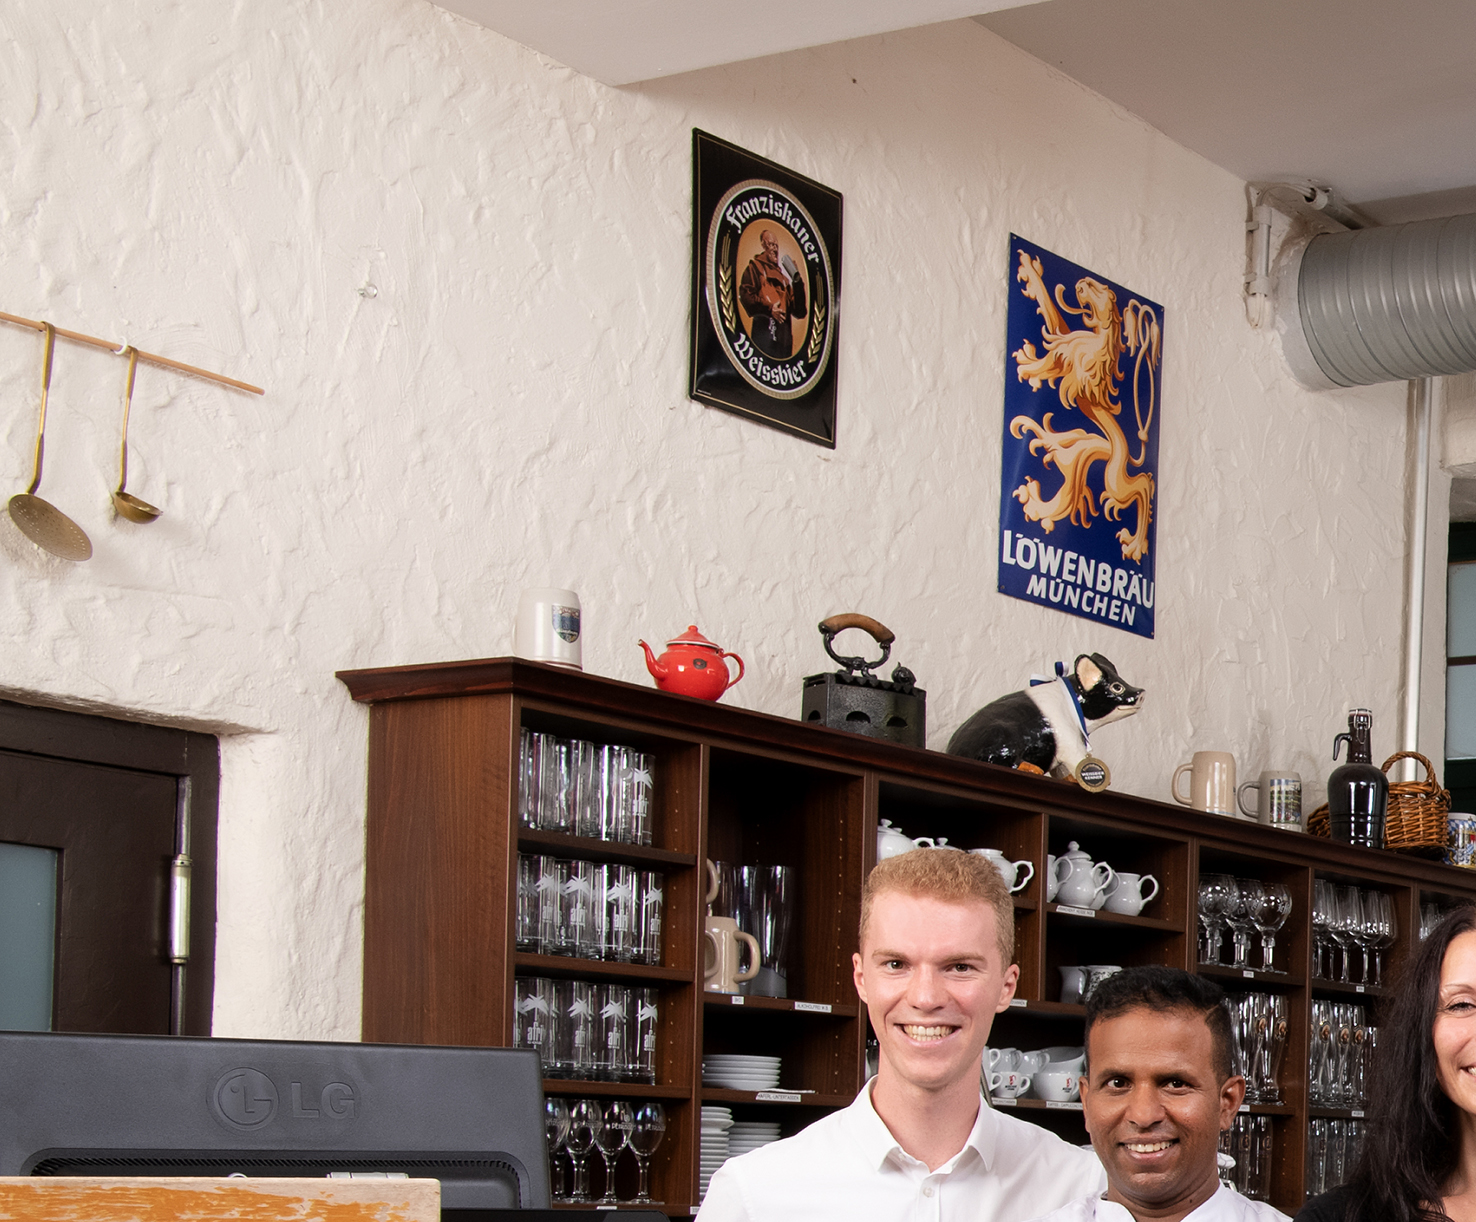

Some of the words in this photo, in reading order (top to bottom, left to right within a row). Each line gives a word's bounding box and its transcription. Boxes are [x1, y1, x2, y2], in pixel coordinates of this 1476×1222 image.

[725, 194, 820, 264] Franziskaner
[733, 332, 807, 387] Weissbier
[1002, 529, 1155, 609] LÖWENBRÄU
[1026, 574, 1136, 626] MÜNCHEN
[291, 1081, 356, 1119] LG
